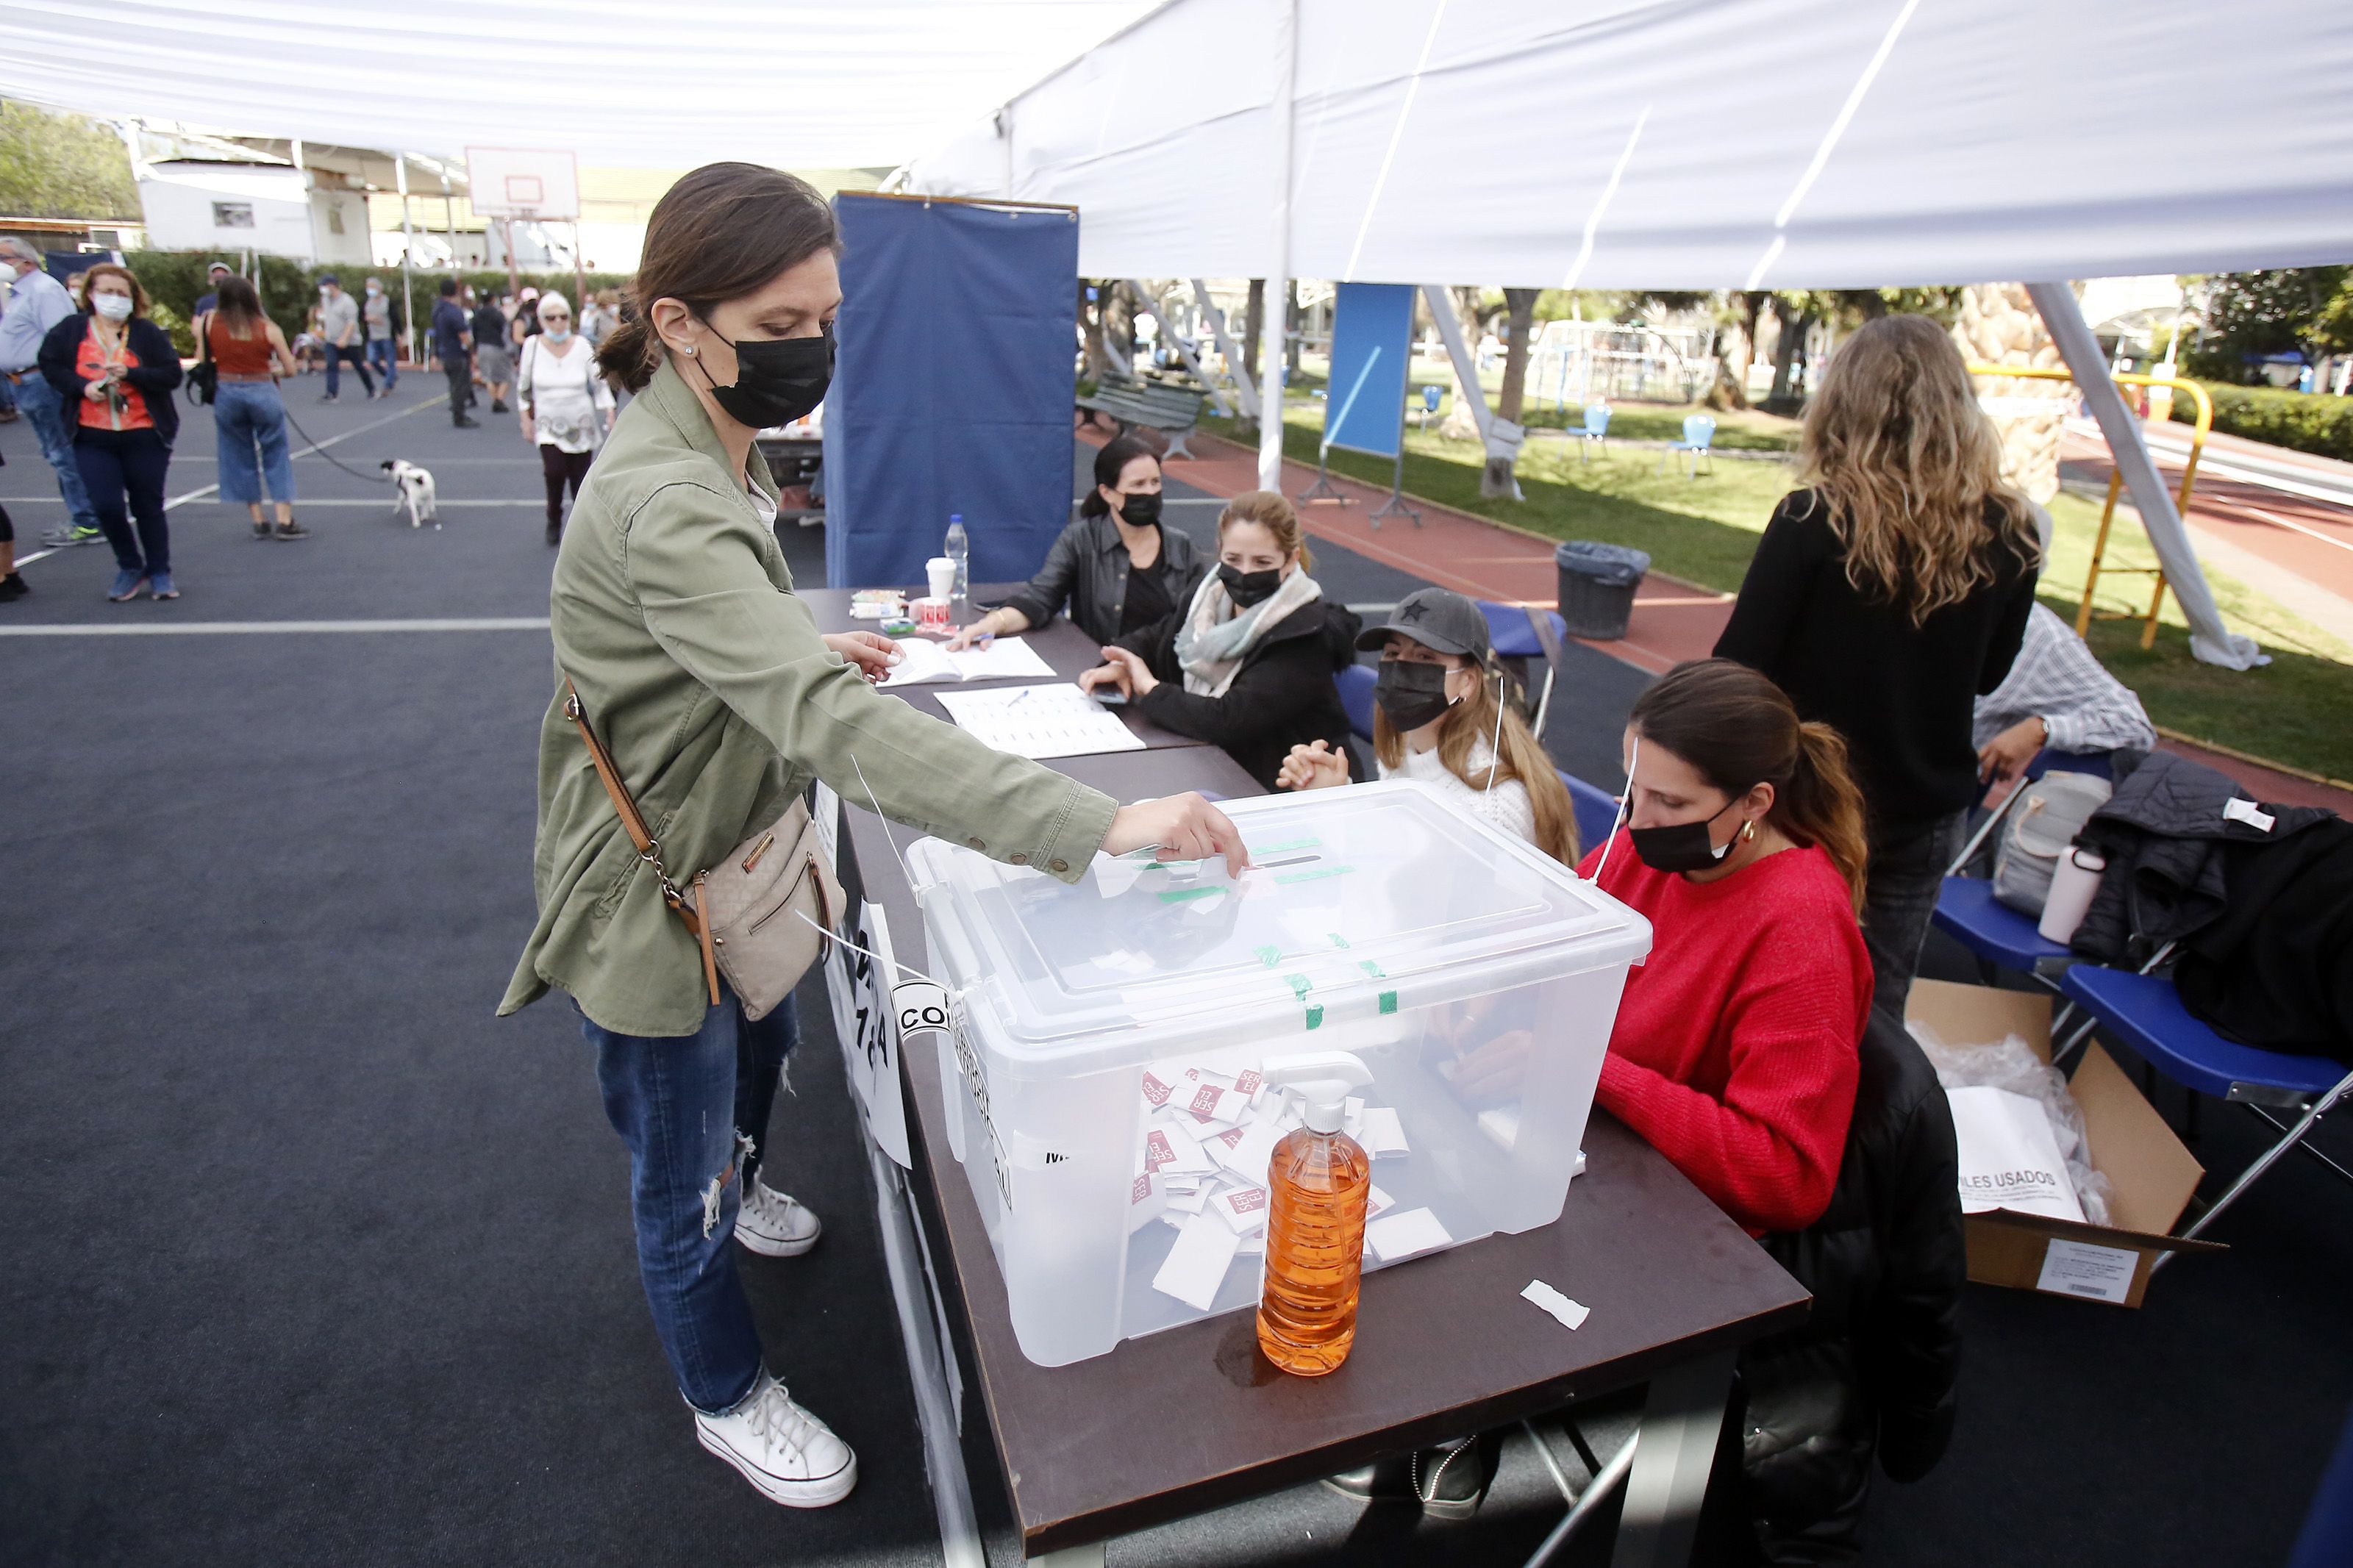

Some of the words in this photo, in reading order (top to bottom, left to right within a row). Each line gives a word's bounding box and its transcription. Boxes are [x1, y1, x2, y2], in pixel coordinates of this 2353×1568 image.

[1240, 1071, 1262, 1084] SER
[1243, 1082, 1255, 1092] EL
[1149, 1085, 1169, 1103] SER
[1200, 1090, 1213, 1100] EL
[1193, 1099, 1214, 1112] SER
[1994, 1170, 2056, 1186] USADOS
[1249, 1189, 1263, 1202] EL
[1234, 1194, 1253, 1211] SER
